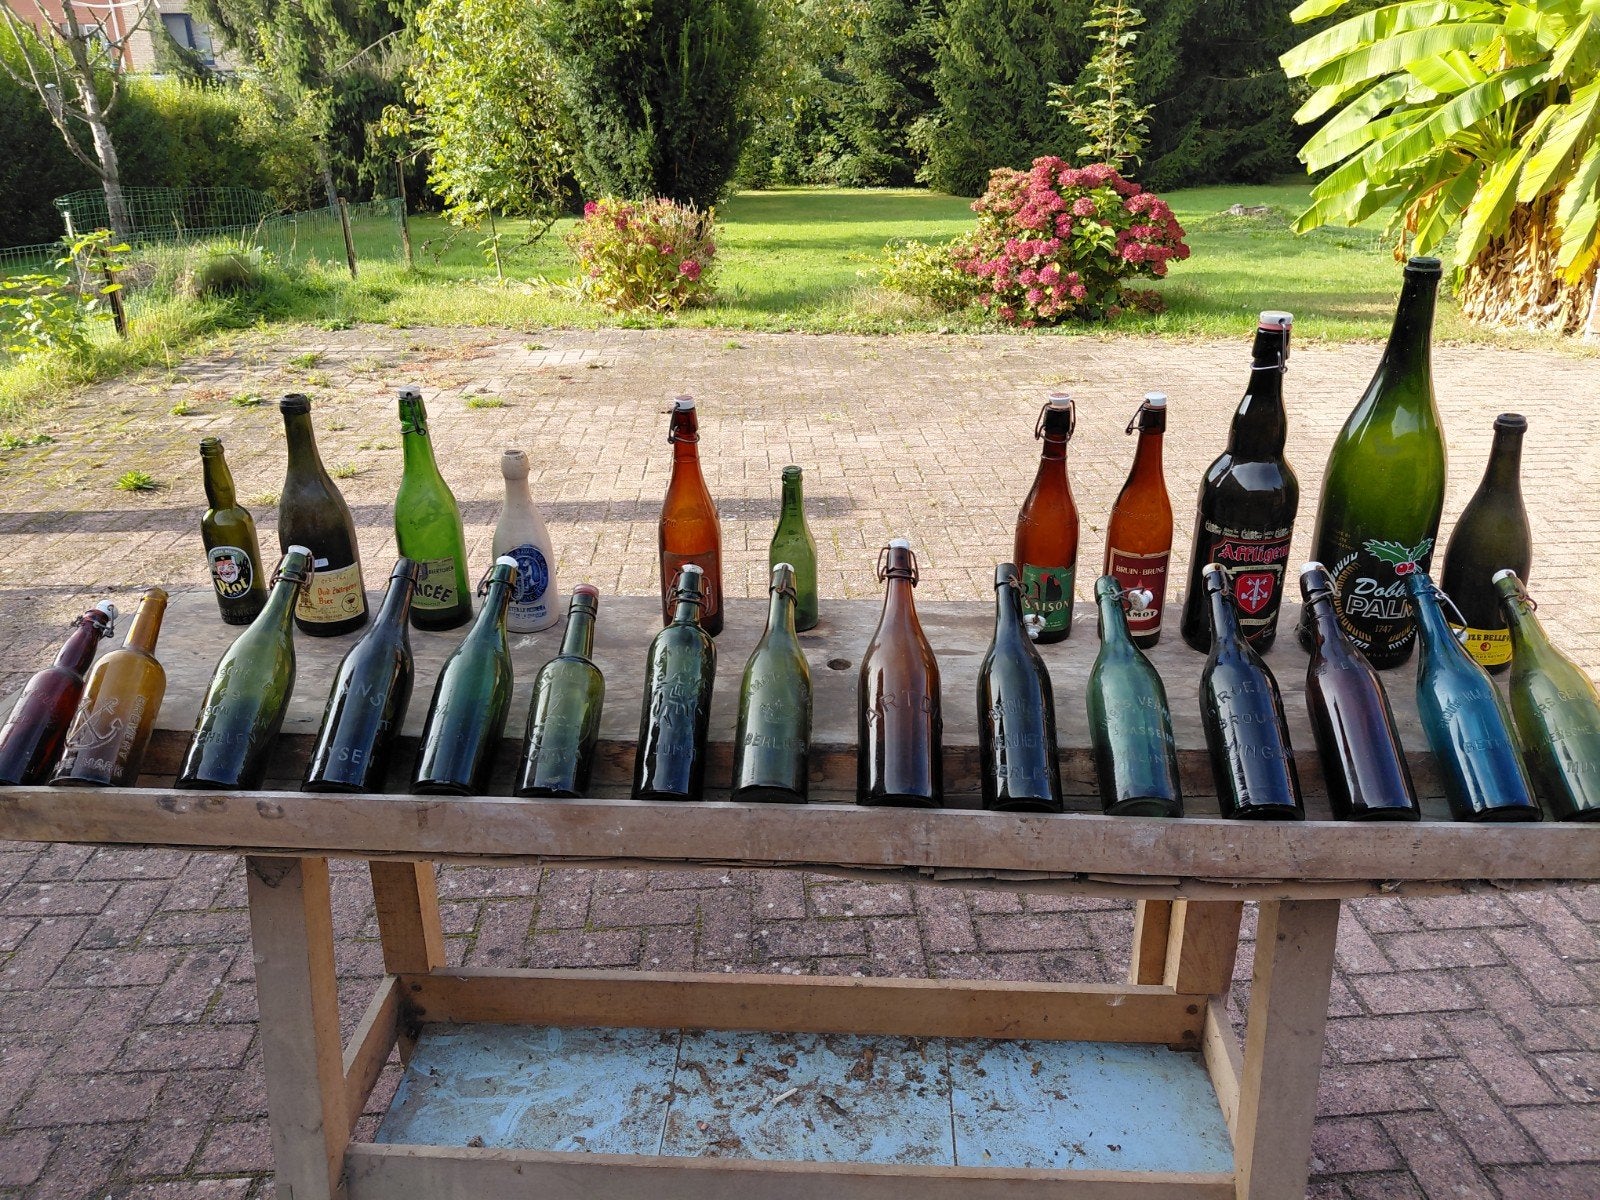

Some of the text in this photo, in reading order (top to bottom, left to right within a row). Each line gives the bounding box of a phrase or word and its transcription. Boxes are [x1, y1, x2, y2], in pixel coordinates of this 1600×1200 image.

[1116, 565, 1138, 575] BRUIN
[1142, 565, 1166, 575] BRUNE
[214, 577, 249, 595] Piot
[414, 584, 453, 602] NCÉE
[1024, 600, 1069, 612] SAISON
[1127, 610, 1156, 618] AMOT
